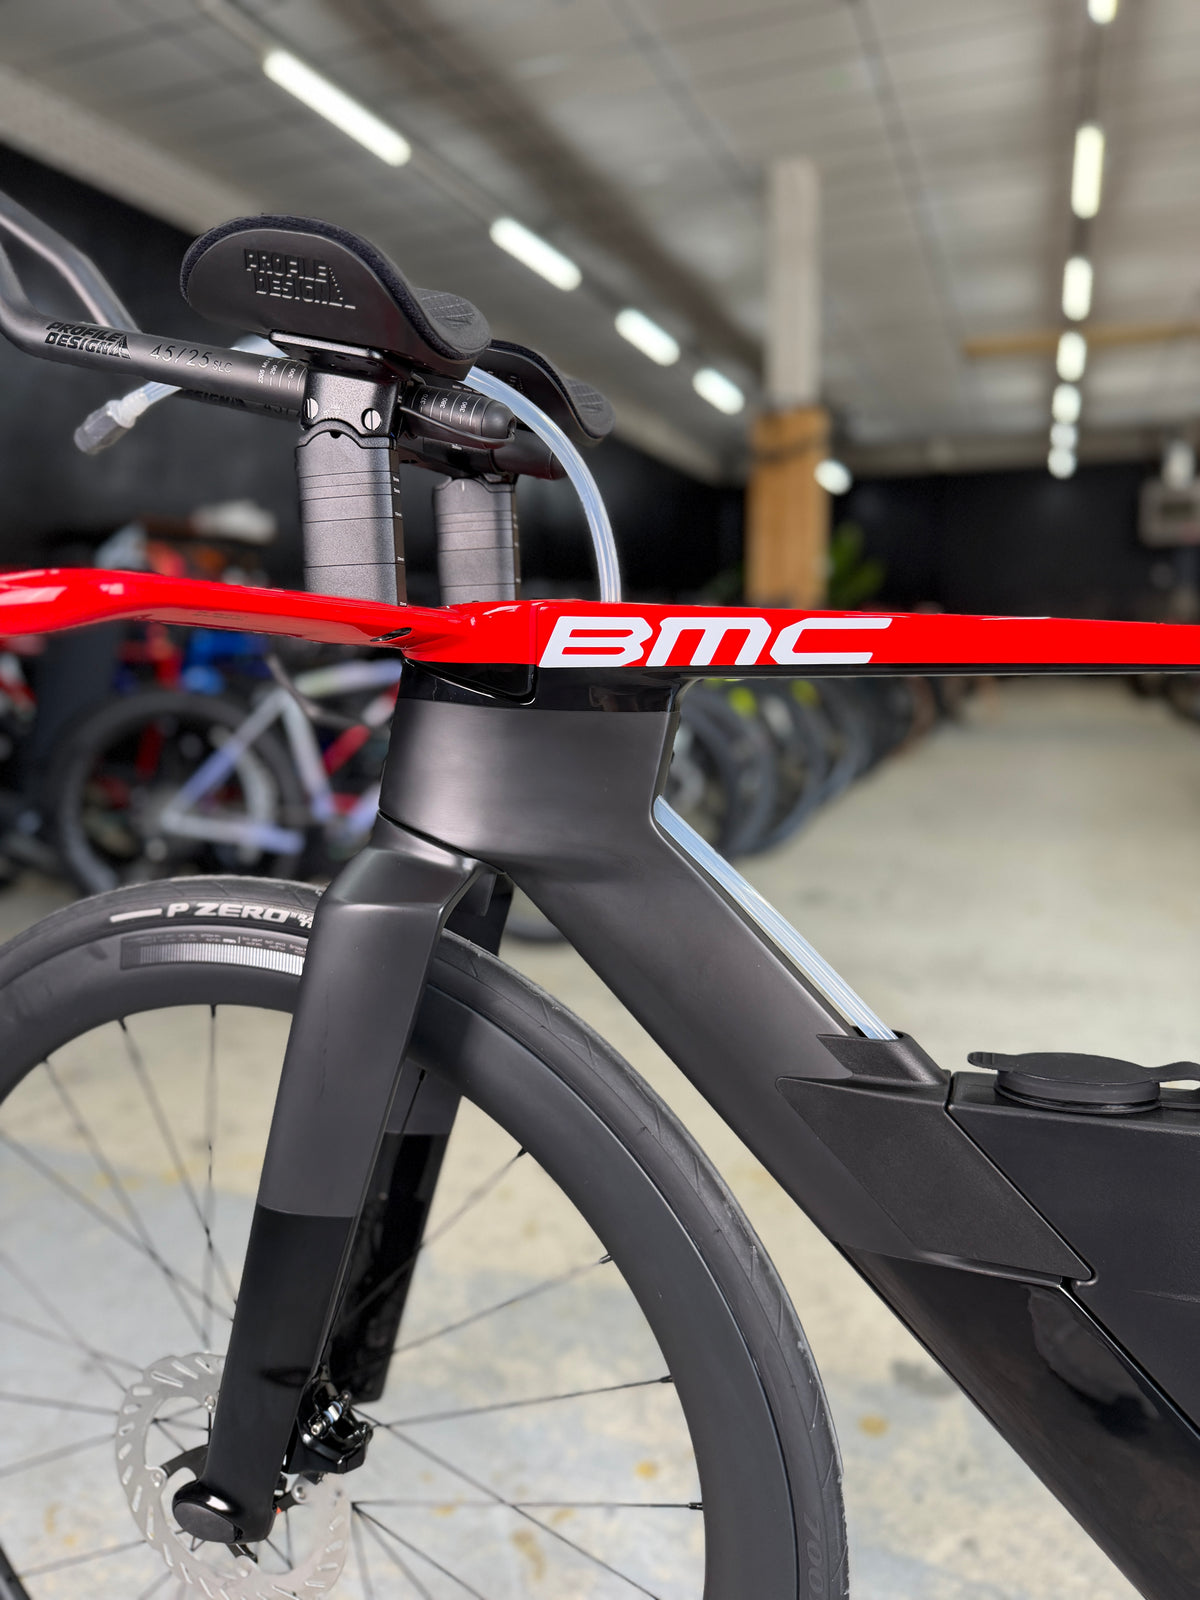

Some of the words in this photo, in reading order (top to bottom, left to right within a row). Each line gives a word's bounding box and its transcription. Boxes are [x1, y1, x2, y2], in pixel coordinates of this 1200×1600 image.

[244, 249, 328, 283] PROFILE
[253, 272, 330, 305] DESIGN
[45, 331, 110, 356] DESIGN
[46, 321, 123, 342] PROFILE
[150, 343, 212, 368] 45/25
[212, 359, 232, 373] SLC
[538, 616, 893, 668] BMC
[166, 903, 189, 918] P
[194, 903, 290, 923] ZERO
